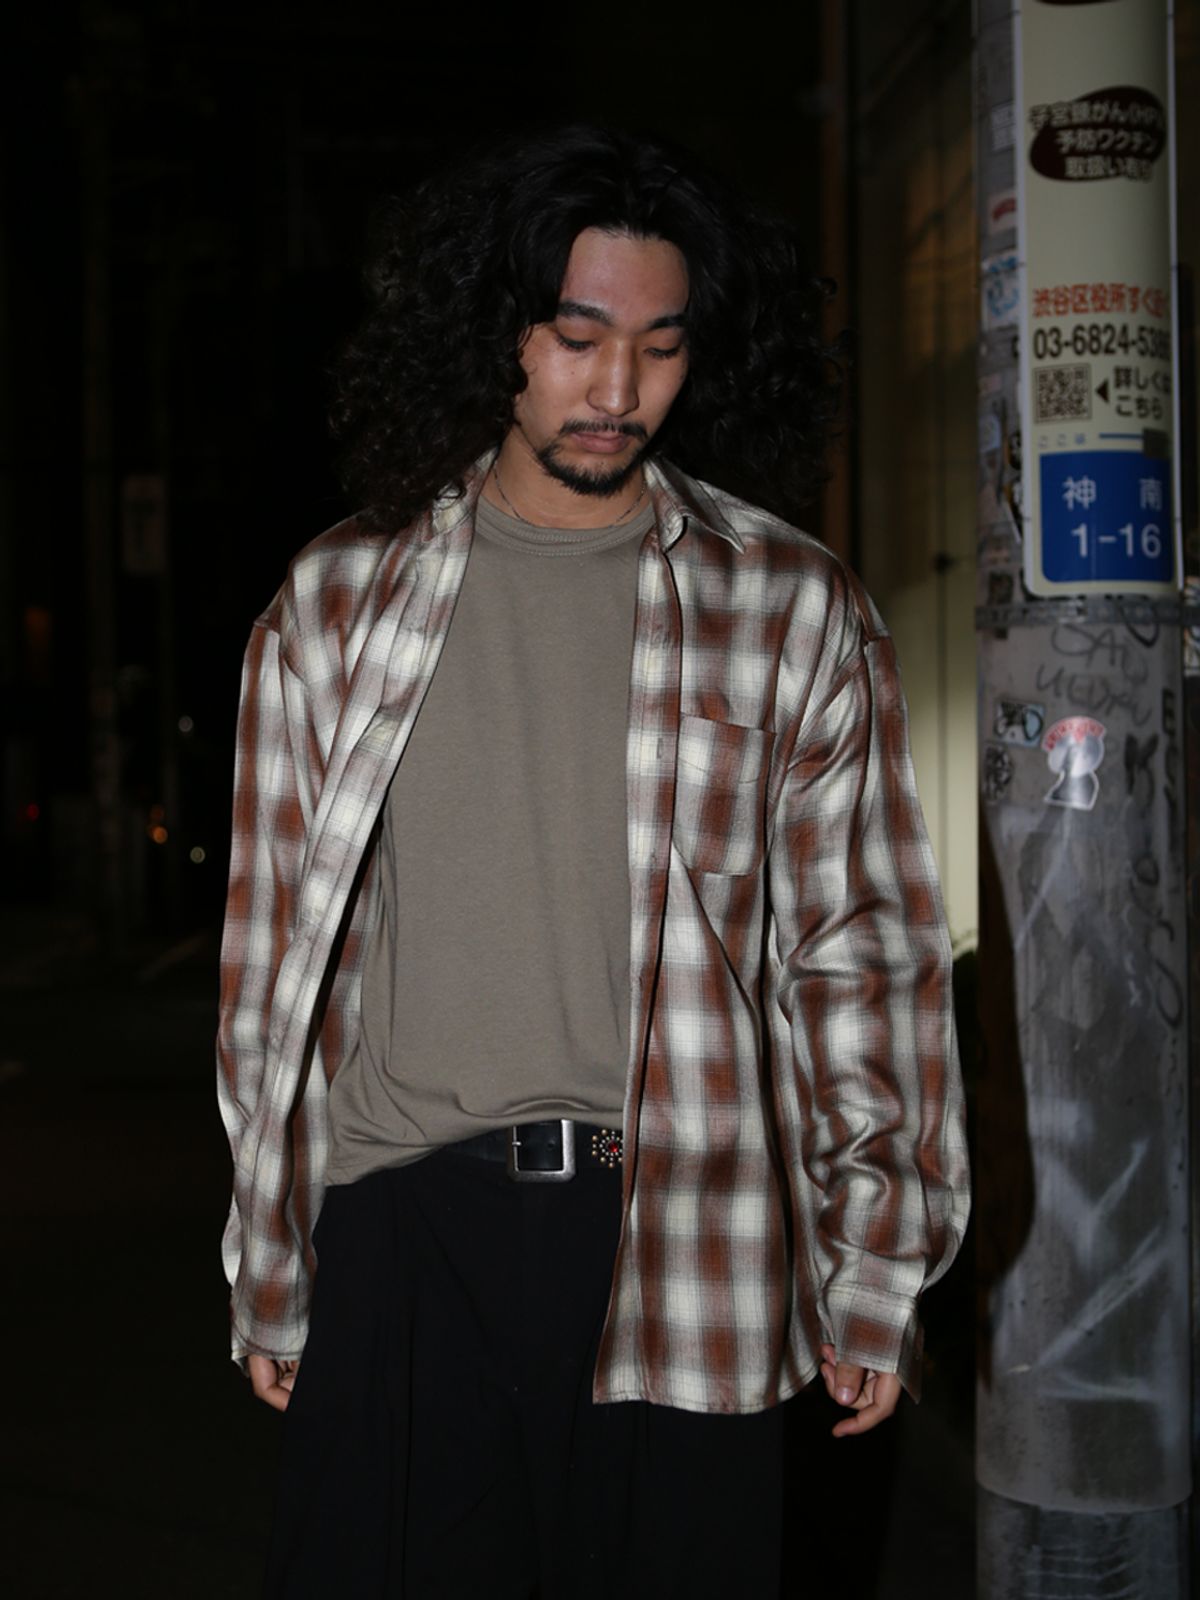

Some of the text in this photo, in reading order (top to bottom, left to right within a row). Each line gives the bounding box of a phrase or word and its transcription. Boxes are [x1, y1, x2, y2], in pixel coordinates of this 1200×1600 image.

[1055, 128, 1158, 154] 予防ワクチン
[1116, 395, 1163, 420] こちら
[1071, 523, 1161, 559] 1-16
